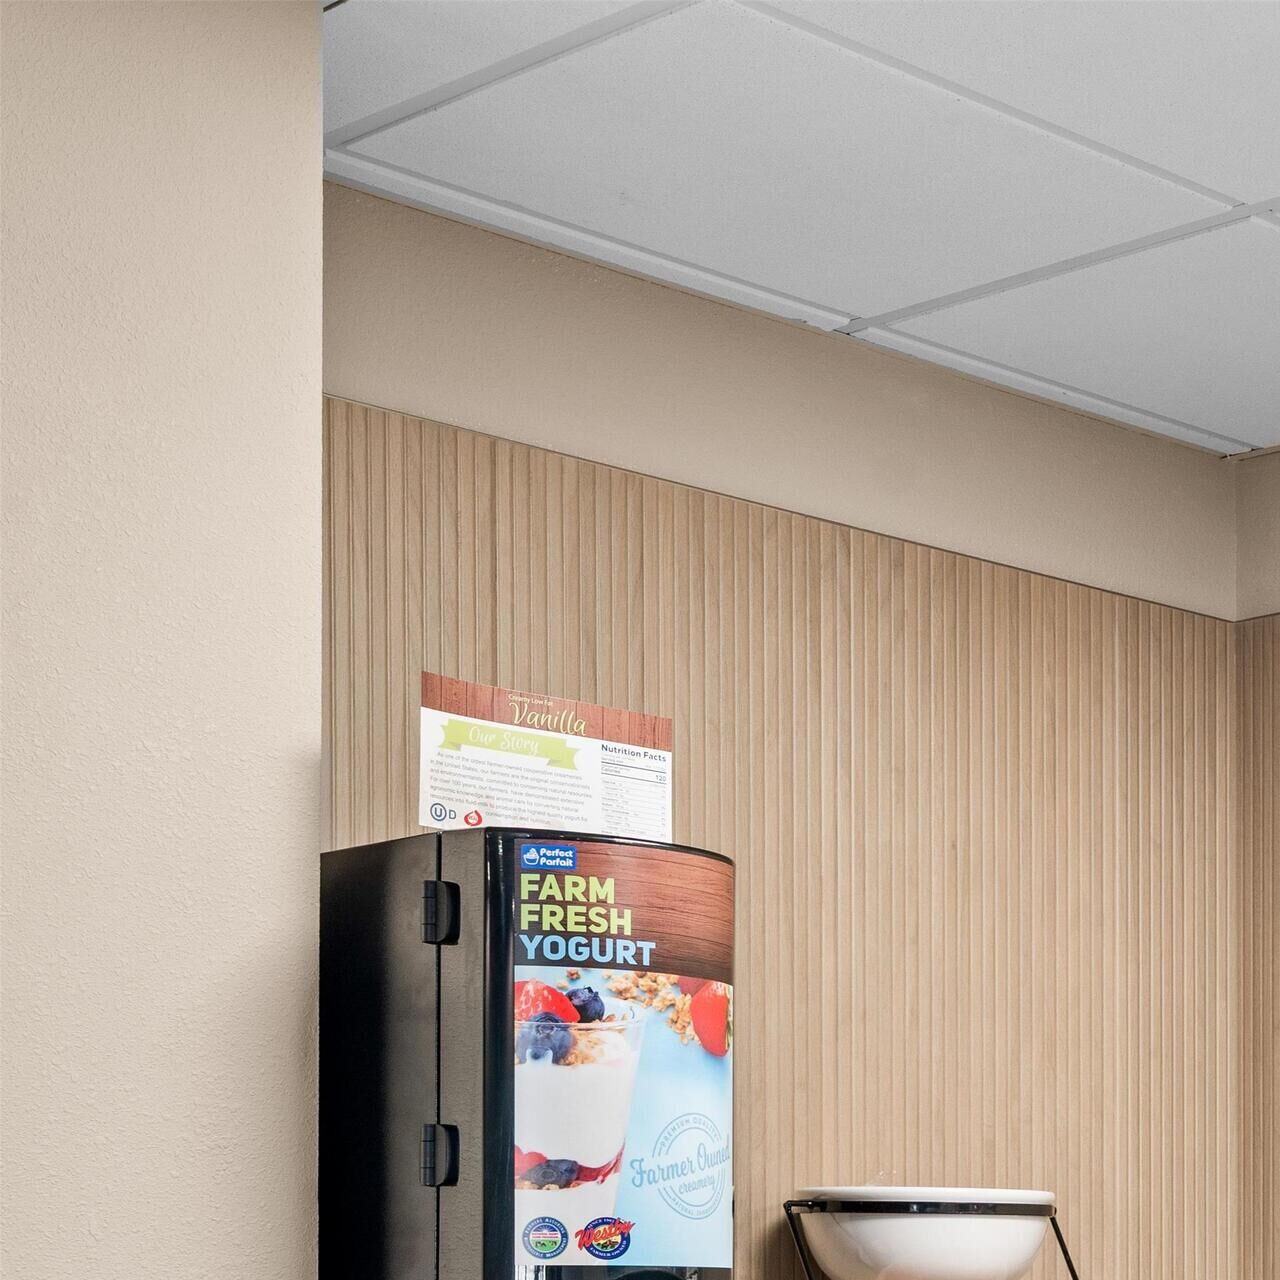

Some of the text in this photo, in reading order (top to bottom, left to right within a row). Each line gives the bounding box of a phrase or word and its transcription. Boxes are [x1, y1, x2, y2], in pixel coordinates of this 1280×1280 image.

[531, 697, 543, 705] Low
[508, 702, 586, 737] Vanilla
[469, 725, 540, 754] Our Story
[601, 744, 667, 762] Nutrition Facts
[655, 774, 667, 782] 120
[540, 848, 573, 858] Perfect
[540, 856, 573, 867] Parfait
[520, 873, 615, 905] FARM
[520, 903, 632, 936] FRESH
[519, 934, 657, 966] YOGURT
[630, 1133, 730, 1188] Farmer Owned
[678, 1175, 715, 1195] creamery
[575, 1217, 637, 1251] Westby
